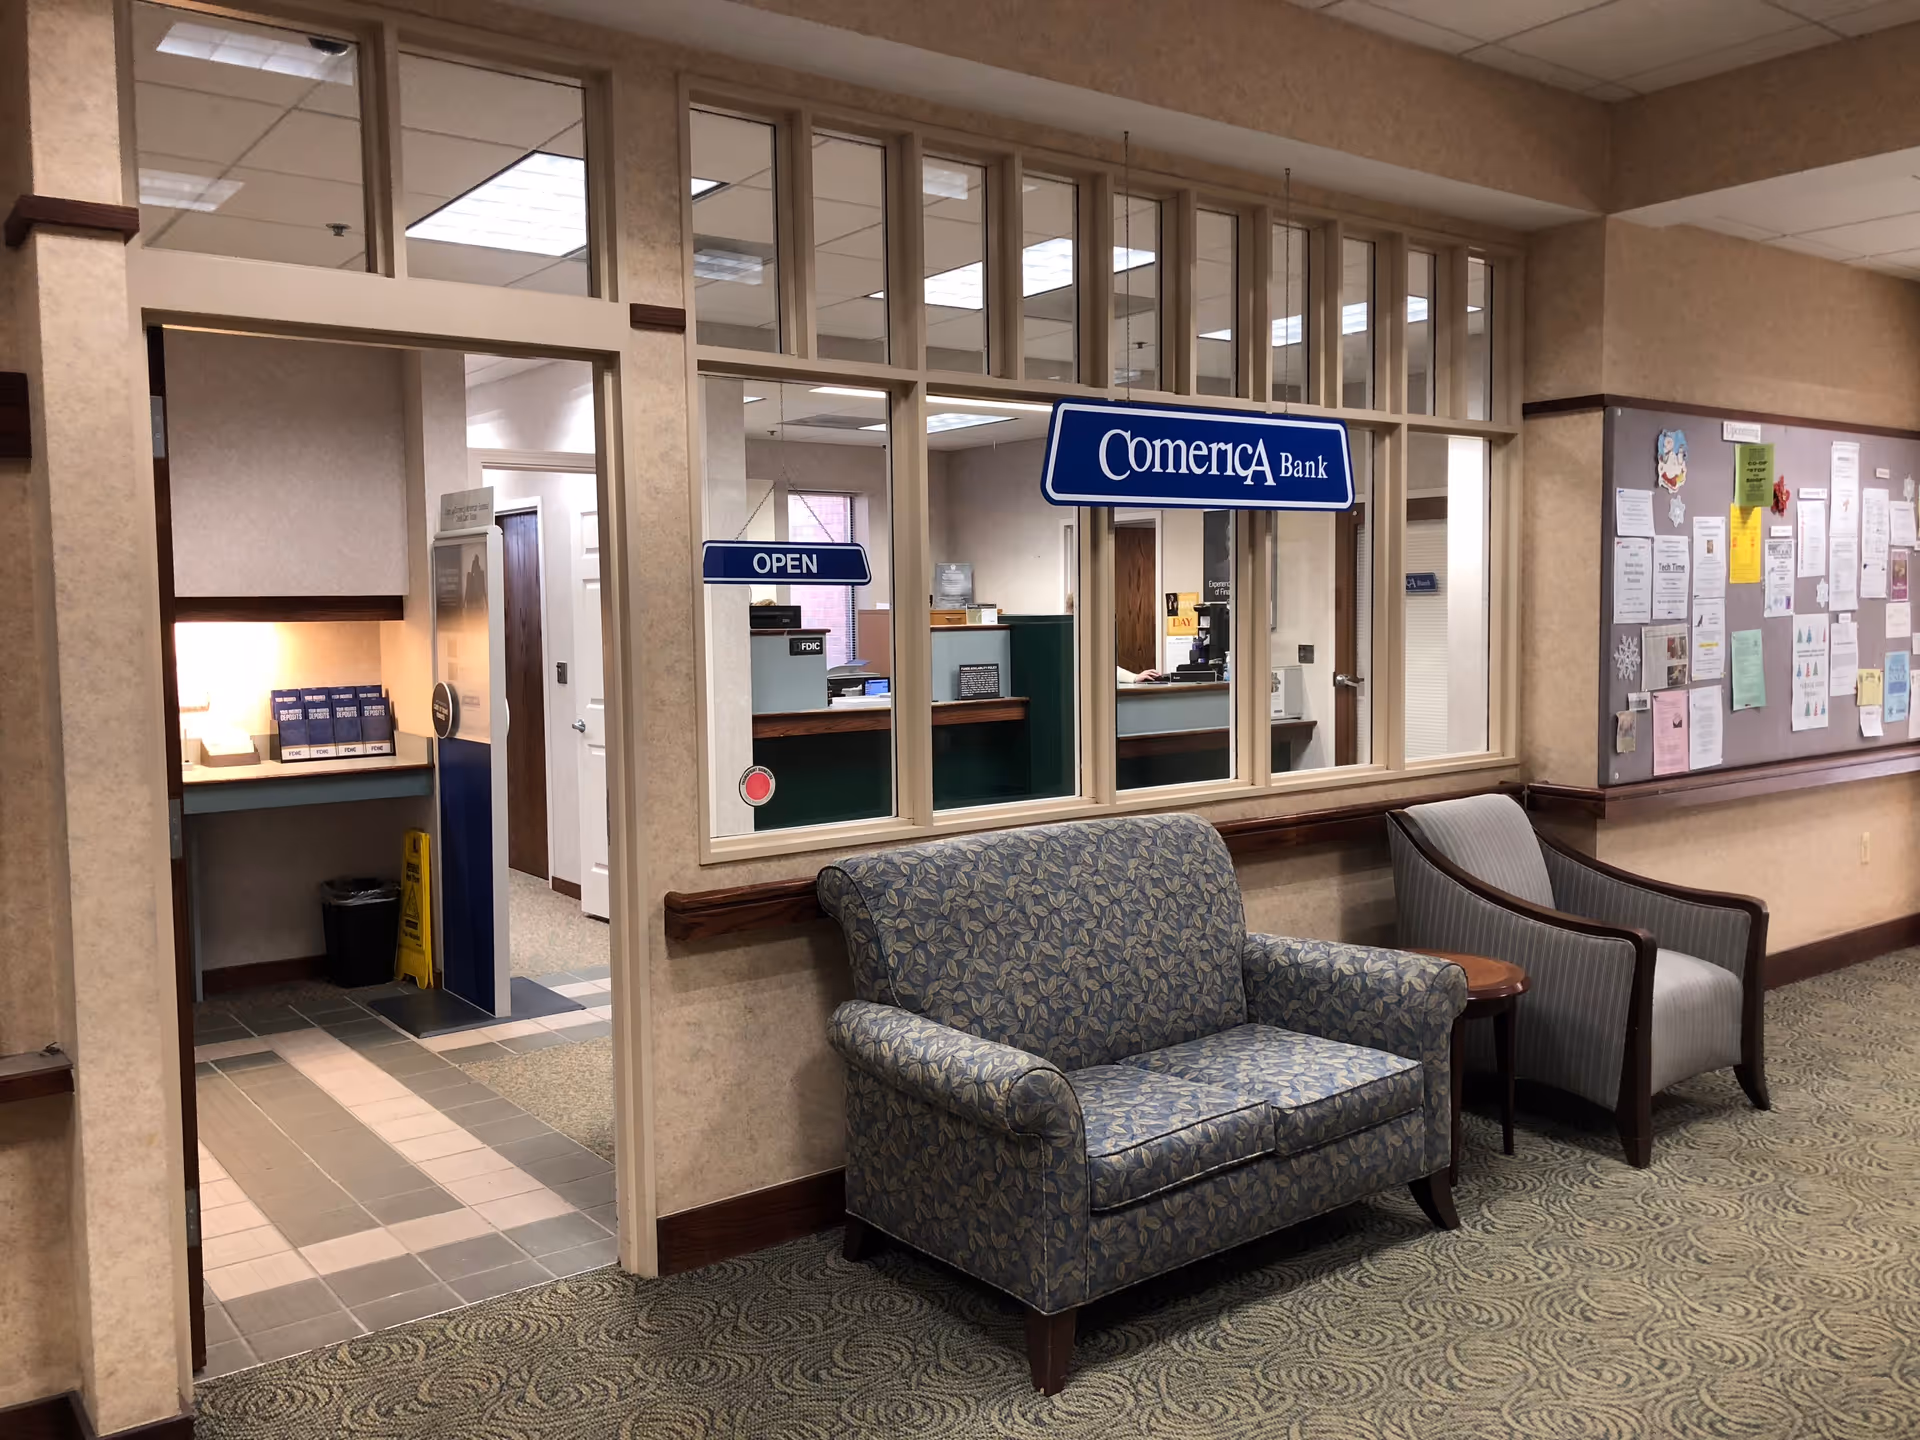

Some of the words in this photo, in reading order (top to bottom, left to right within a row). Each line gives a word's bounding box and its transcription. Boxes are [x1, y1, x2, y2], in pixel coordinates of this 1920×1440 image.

[1280, 452, 1328, 478] Bank
[753, 553, 818, 574] OPEN
[1658, 563, 1670, 572] Tech
[1672, 562, 1685, 570] Time
[1208, 580, 1230, 588] Experienc
[1220, 588, 1230, 596] Fina
[1172, 618, 1192, 627] DAY
[802, 642, 820, 650] FDIC
